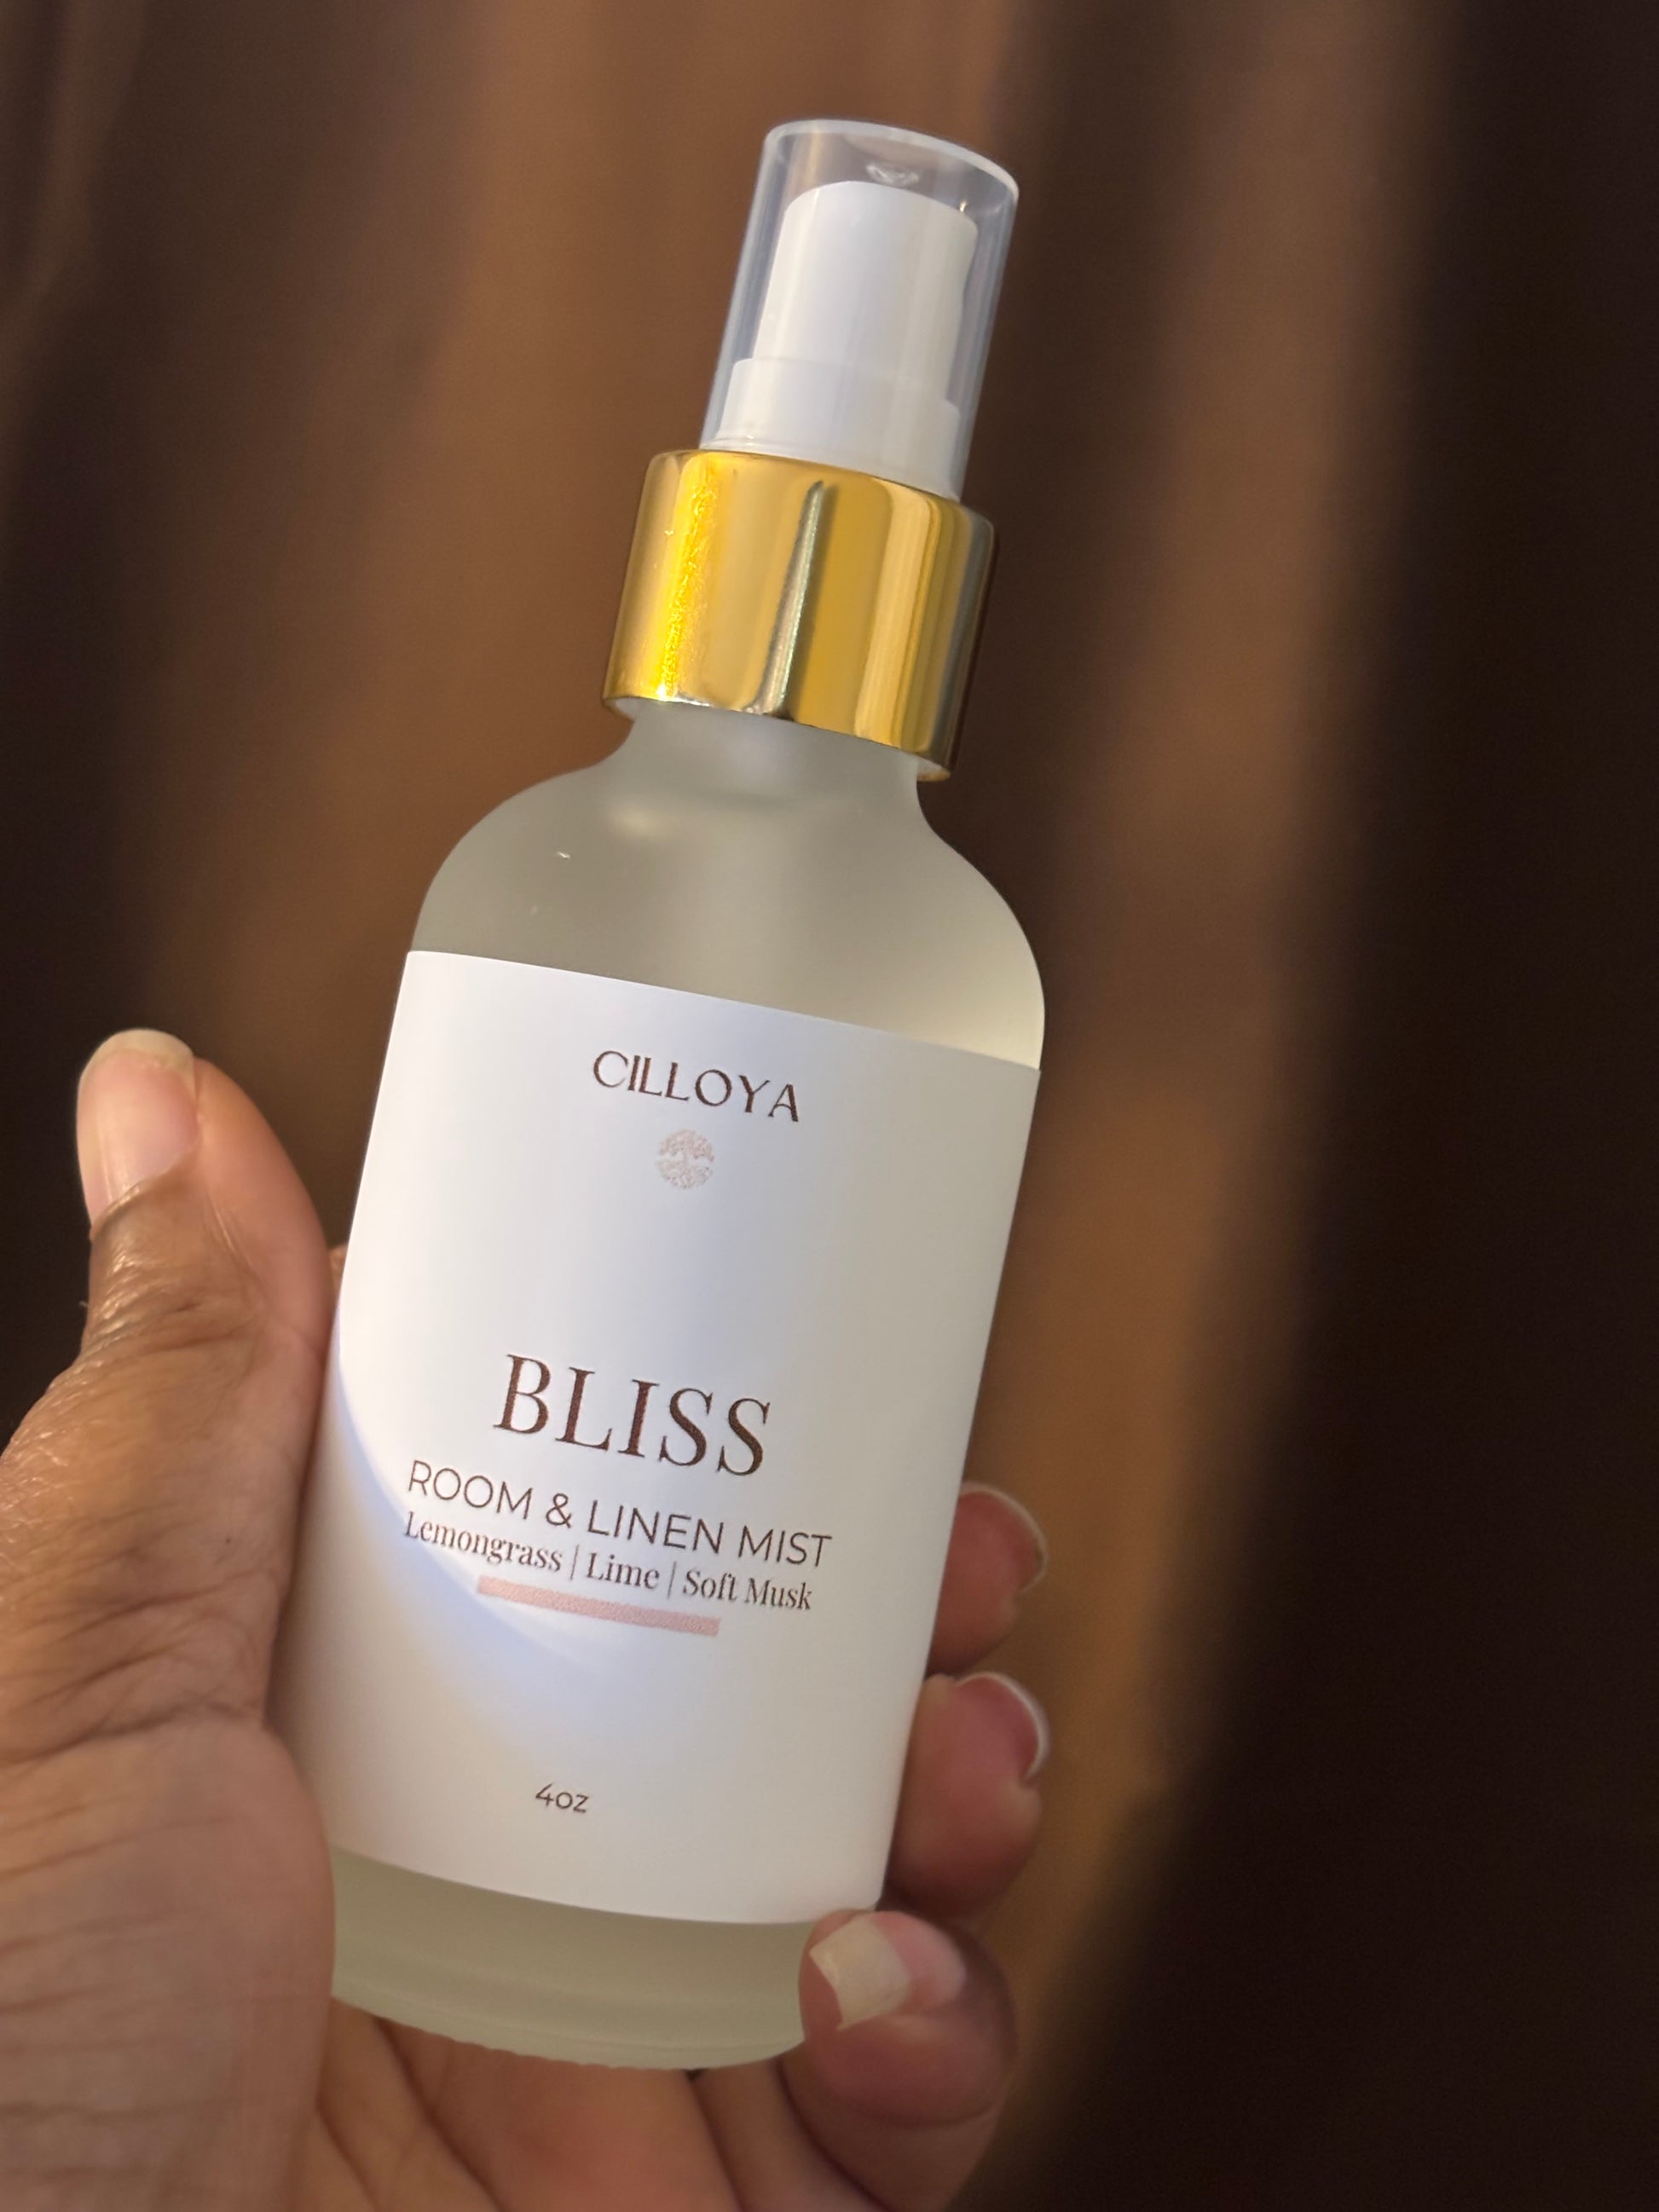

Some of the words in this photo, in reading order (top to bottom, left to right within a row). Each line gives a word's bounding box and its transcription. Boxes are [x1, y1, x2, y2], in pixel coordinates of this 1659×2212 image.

[593, 1049, 799, 1123] CILLOYA
[493, 1354, 771, 1476] BLISS
[404, 1510, 563, 1573] Lemongrass
[586, 1551, 661, 1590] Lime
[683, 1568, 738, 1603] Soft
[744, 1577, 812, 1611] Musk
[408, 1458, 534, 1520] ROOM
[546, 1493, 573, 1529] &
[587, 1499, 725, 1555] LINEN
[737, 1524, 832, 1568] MIST
